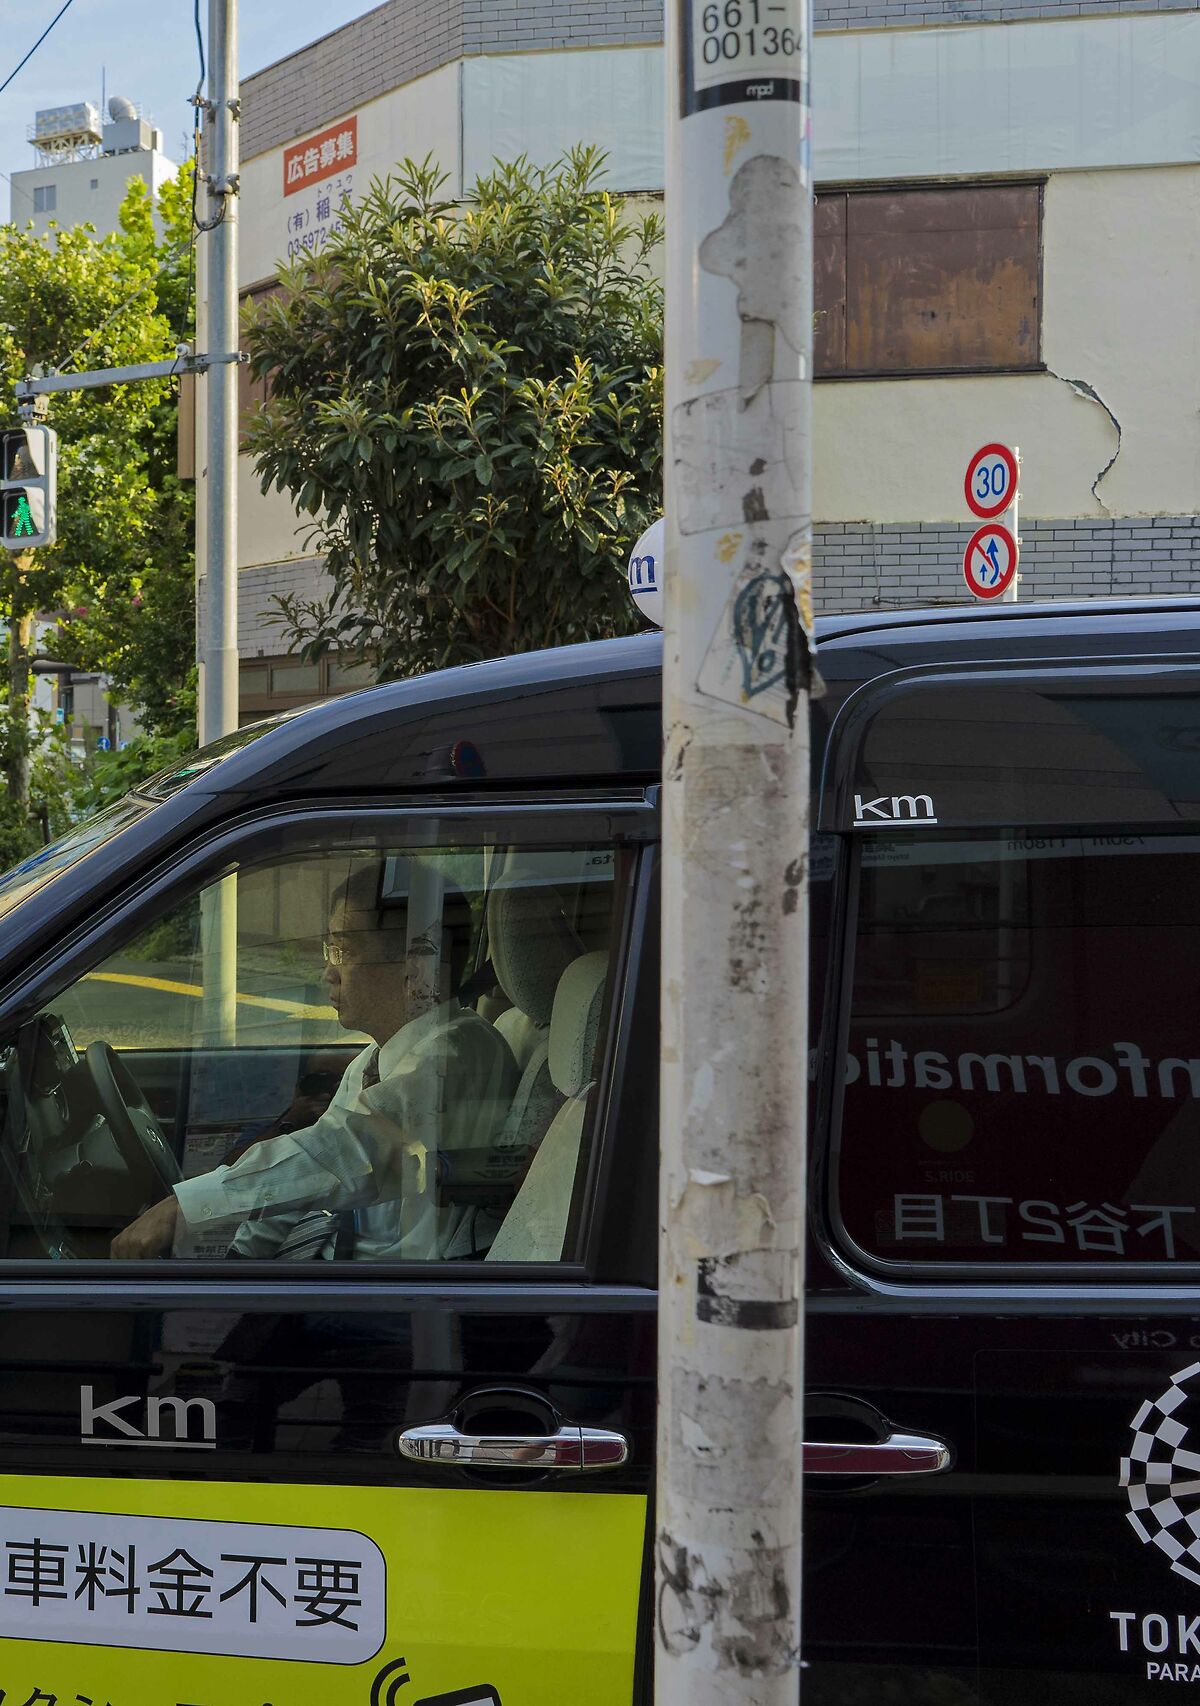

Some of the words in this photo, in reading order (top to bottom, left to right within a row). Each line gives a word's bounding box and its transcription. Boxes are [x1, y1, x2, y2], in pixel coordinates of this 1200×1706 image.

[287, 131, 354, 184] 広告募集
[976, 463, 1006, 500] 30
[853, 793, 937, 824] km
[80, 1384, 217, 1446] km
[1109, 1611, 1200, 1654] TOK
[1146, 1661, 1200, 1682] PARA
